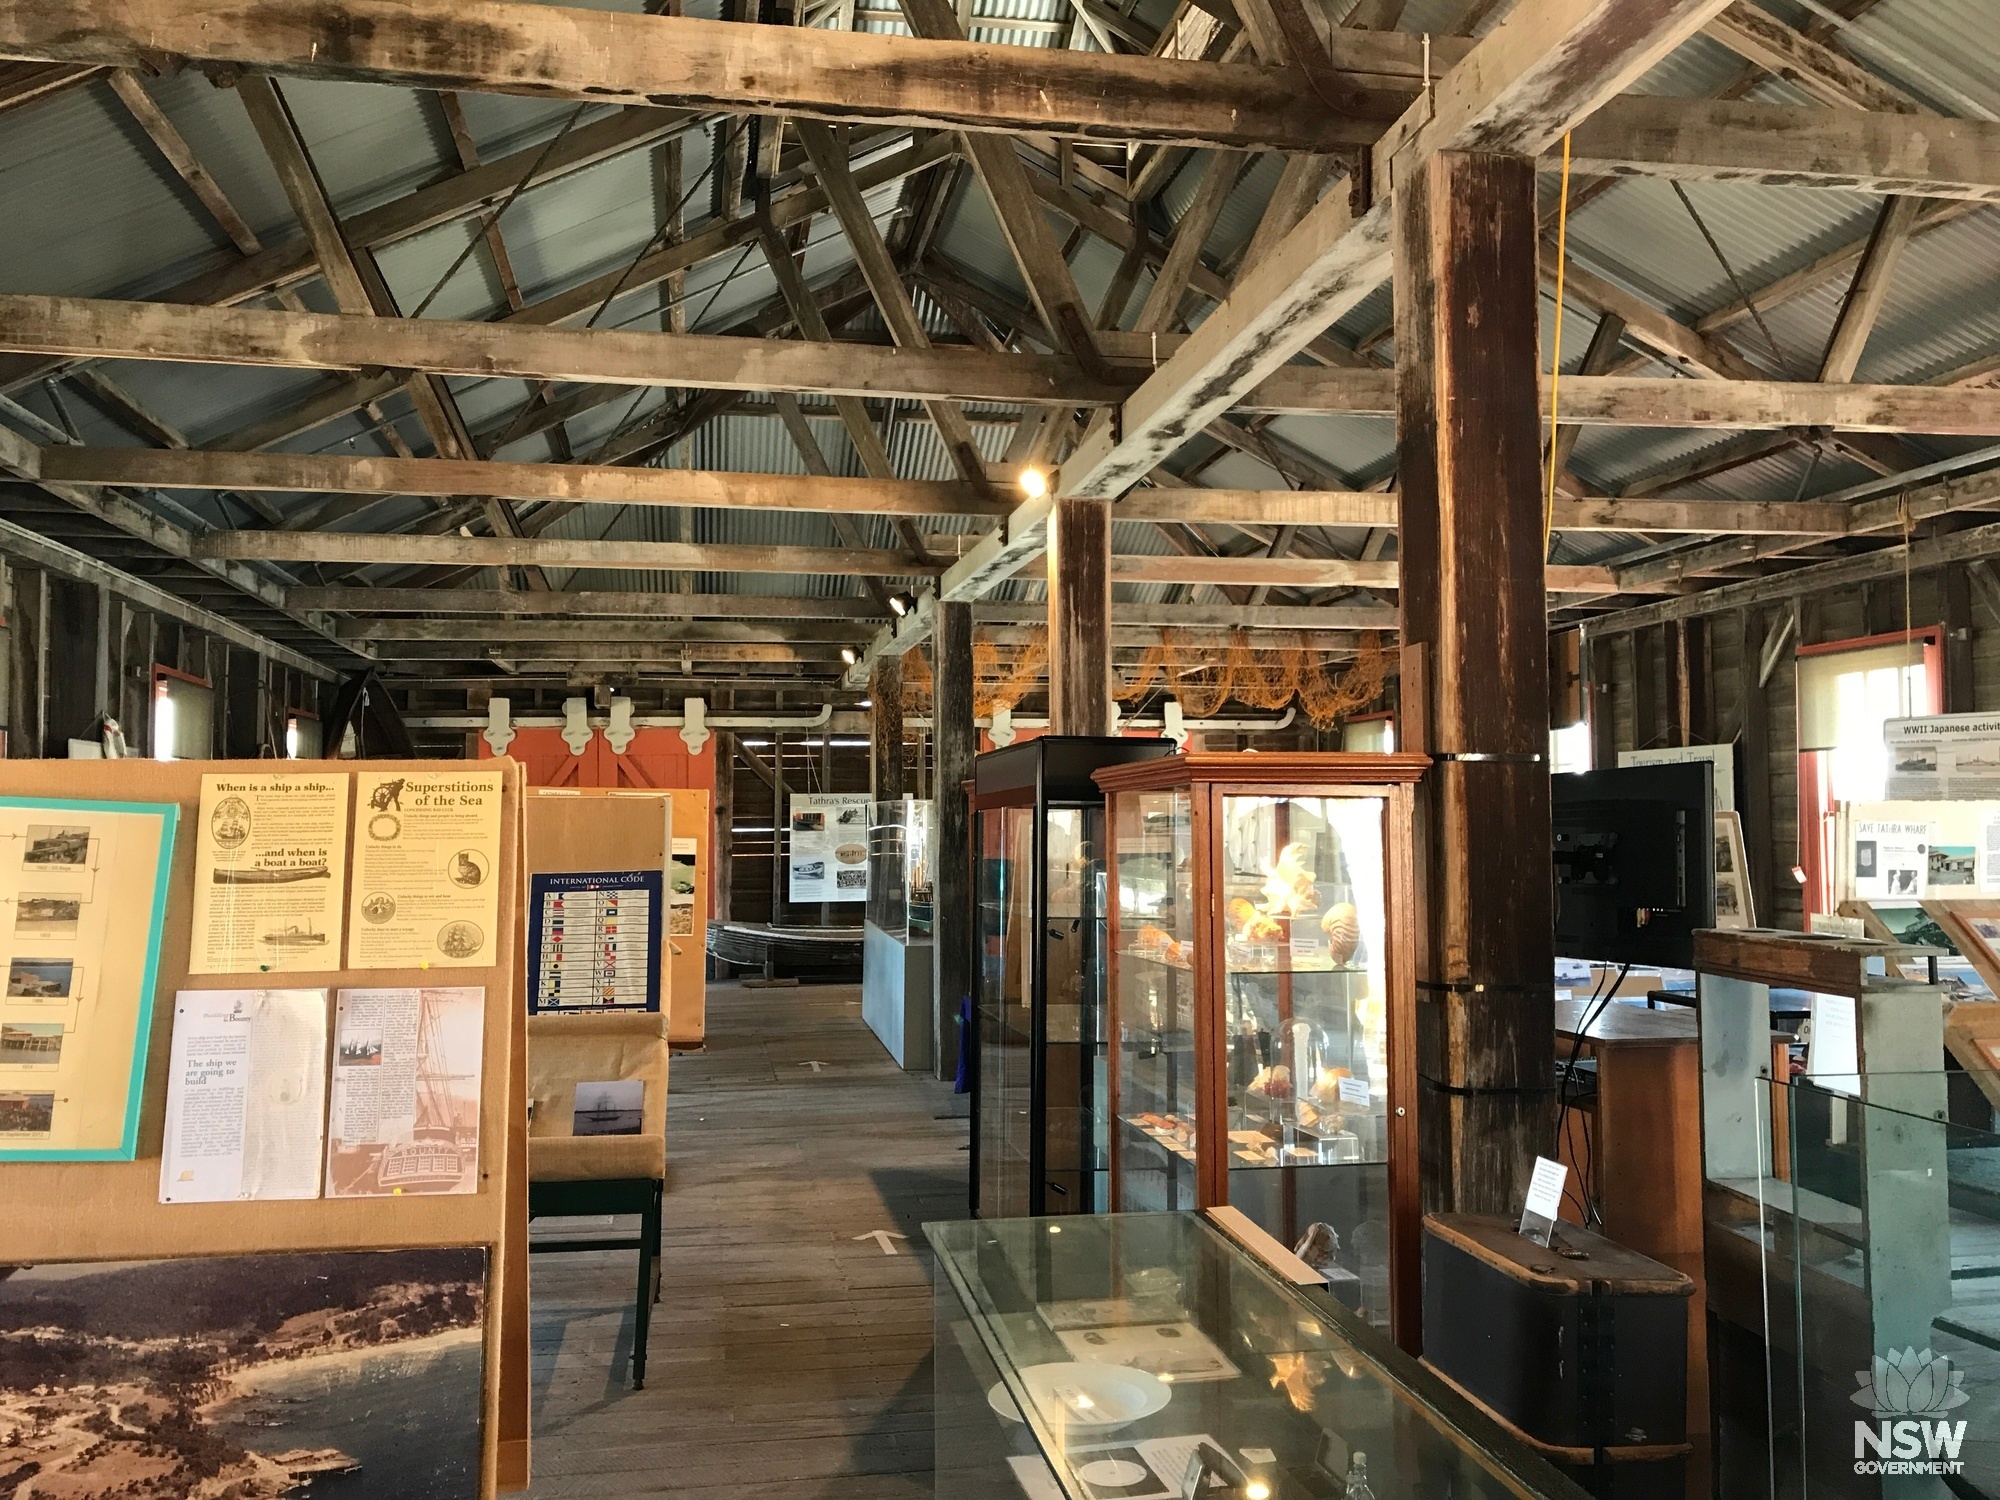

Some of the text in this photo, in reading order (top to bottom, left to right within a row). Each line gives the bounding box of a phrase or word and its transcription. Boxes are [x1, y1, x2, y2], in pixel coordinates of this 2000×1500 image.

[1903, 725, 1928, 734] WWII
[1930, 724, 1970, 735] Japanese
[216, 783, 246, 792] When
[249, 783, 258, 792] is
[270, 783, 292, 793] ship
[294, 784, 301, 792] a
[304, 782, 334, 792] ship...
[406, 781, 494, 794] Superstitions
[415, 795, 483, 806] of the Sea
[1859, 823, 1873, 833] SAVE
[1905, 824, 1927, 834] WHARF
[255, 848, 284, 857] ...and
[287, 848, 315, 856] when
[318, 848, 327, 856] is
[264, 858, 286, 866] boat
[299, 858, 327, 866] boat?
[229, 1014, 251, 1023] Bounty
[206, 1059, 223, 1068] ship
[200, 1068, 224, 1077] going
[185, 1076, 206, 1085] build
[402, 1147, 449, 1156] BOUNTY
